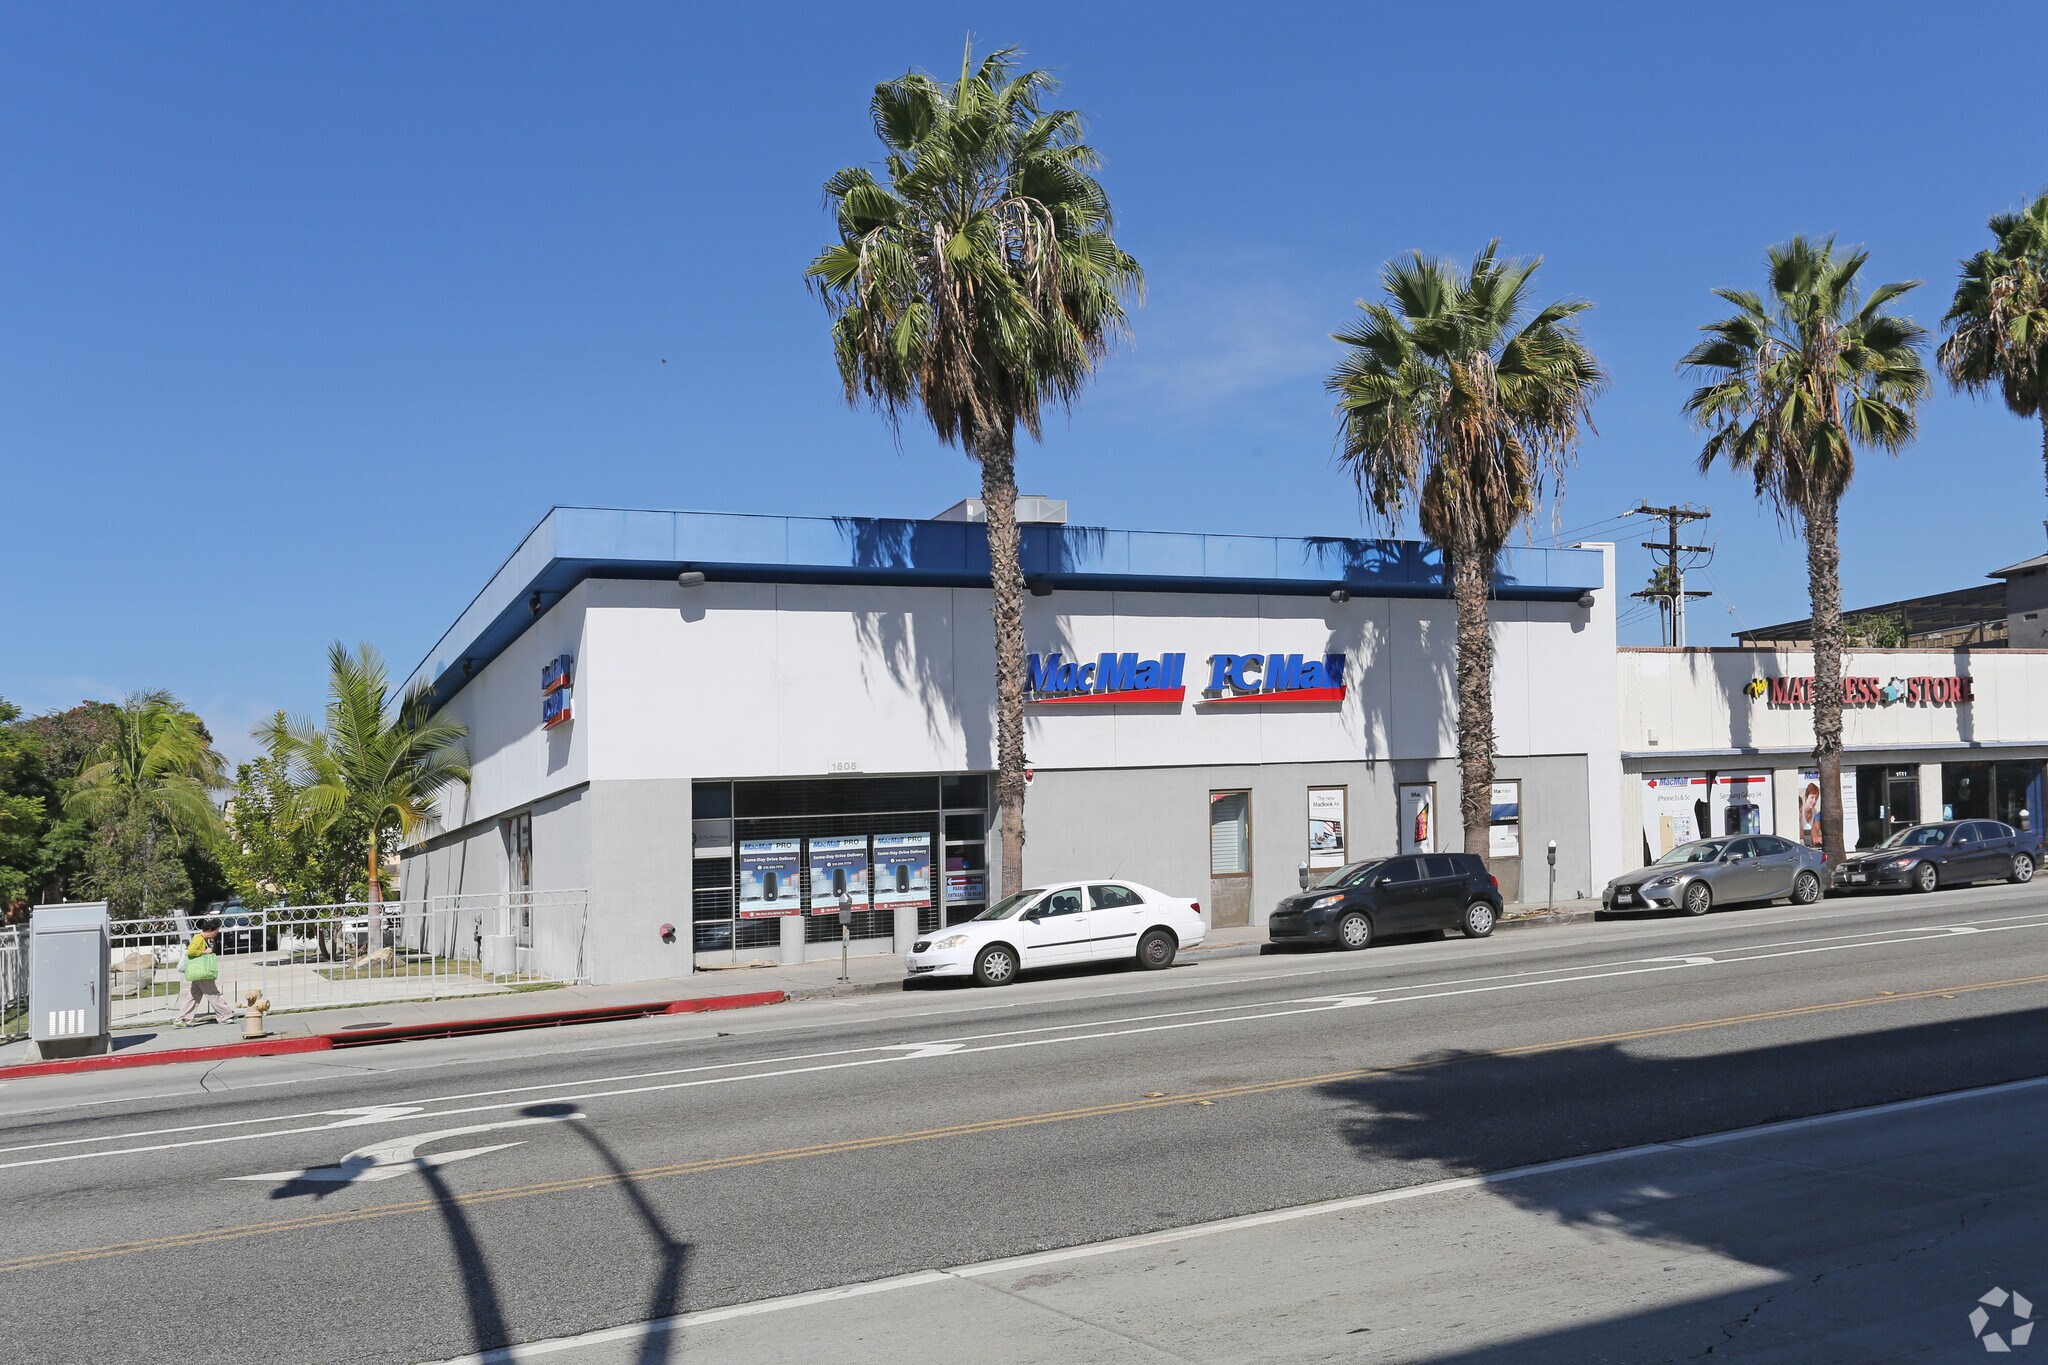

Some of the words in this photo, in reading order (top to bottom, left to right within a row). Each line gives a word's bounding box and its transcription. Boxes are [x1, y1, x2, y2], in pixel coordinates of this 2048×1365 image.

[1023, 653, 1186, 692] MacMall
[1204, 654, 1346, 691] PCMall
[1771, 677, 1880, 704] MATESS
[1909, 677, 1974, 702] STORE
[1659, 777, 1688, 786] MacMall
[1719, 792, 1740, 800] Samsung
[1740, 791, 1756, 800] Galaxy
[812, 840, 841, 849] MacMall
[877, 836, 905, 845] MacMall
[744, 842, 773, 851] MacMall
